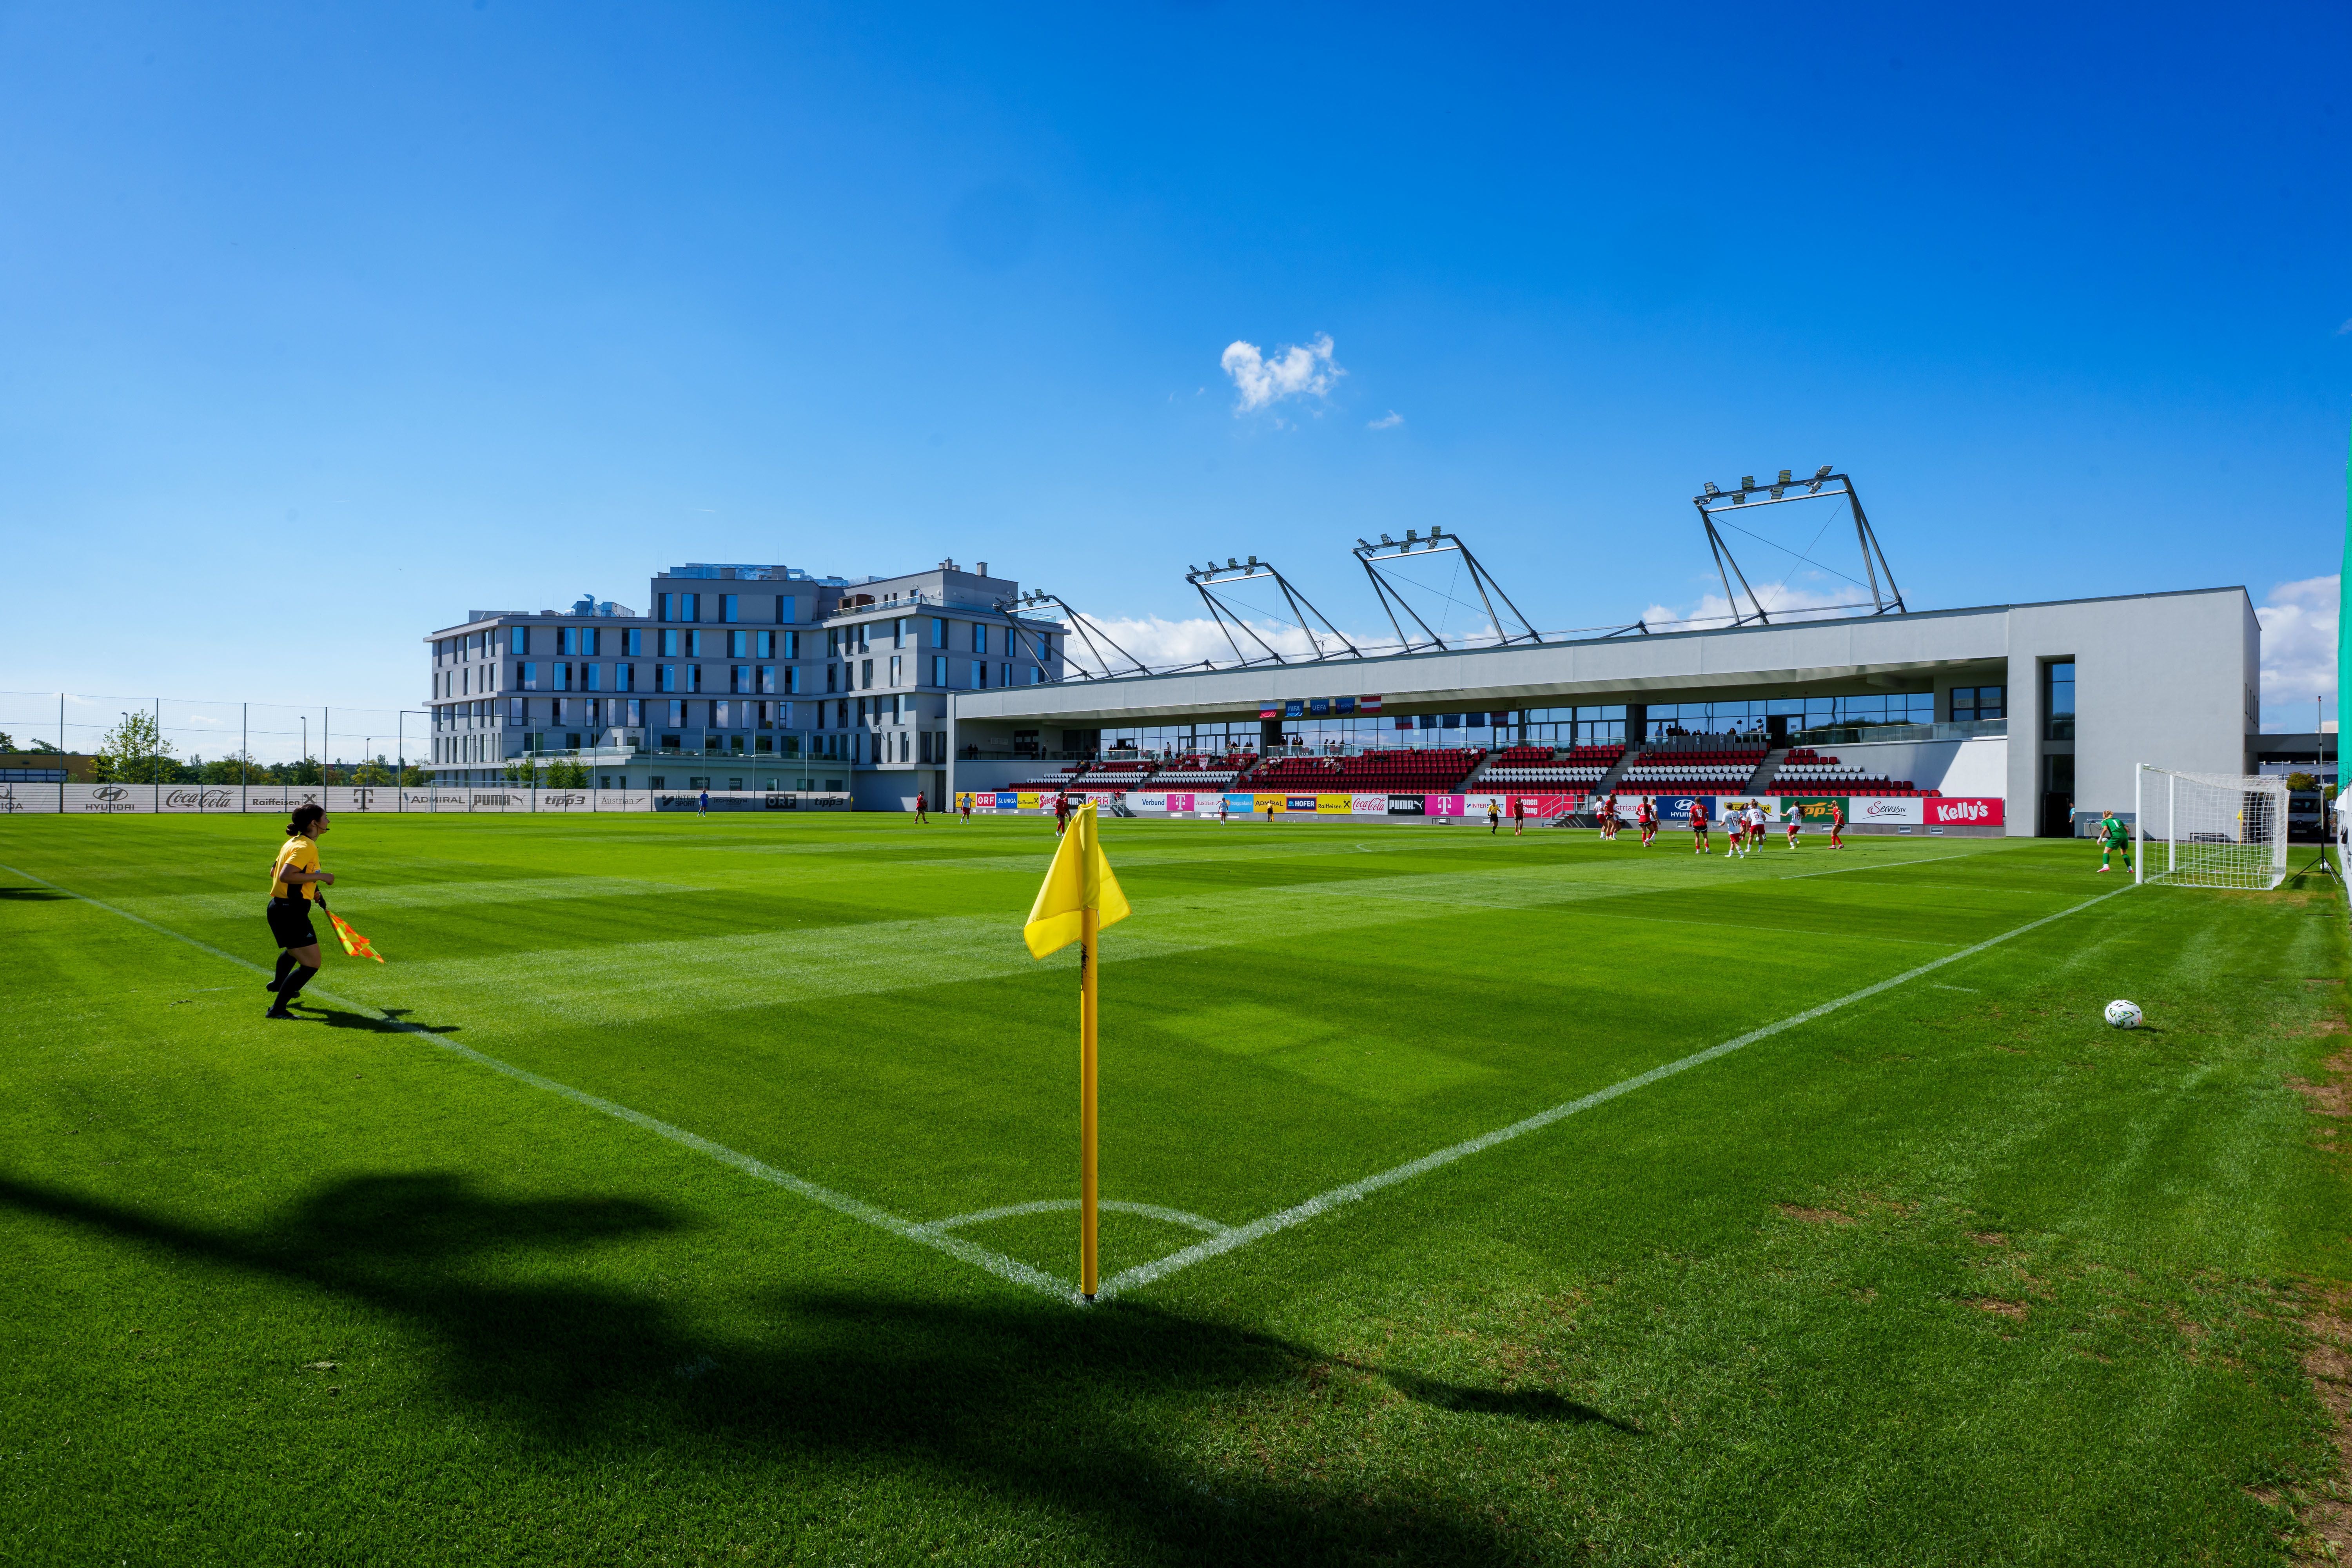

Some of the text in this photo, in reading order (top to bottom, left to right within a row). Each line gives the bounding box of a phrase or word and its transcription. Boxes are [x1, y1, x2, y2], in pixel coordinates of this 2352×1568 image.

[353, 789, 374, 810] T
[474, 795, 510, 806] PUMA
[545, 794, 586, 807] tipp3
[768, 797, 795, 806] ORF
[814, 796, 844, 807] tipp3
[1040, 794, 1056, 809] Stiegl
[1176, 795, 1185, 810] T
[1352, 797, 1386, 811] Coca-Cola
[1389, 800, 1414, 809] PUMA
[1438, 796, 1451, 814] T
[1523, 806, 1538, 815] itung
[1695, 808, 1702, 817] 18
[1794, 811, 1800, 820] 16
[1937, 801, 1988, 822] Kelly's
[1730, 817, 1737, 827] 15
[2112, 819, 2119, 828] 1
